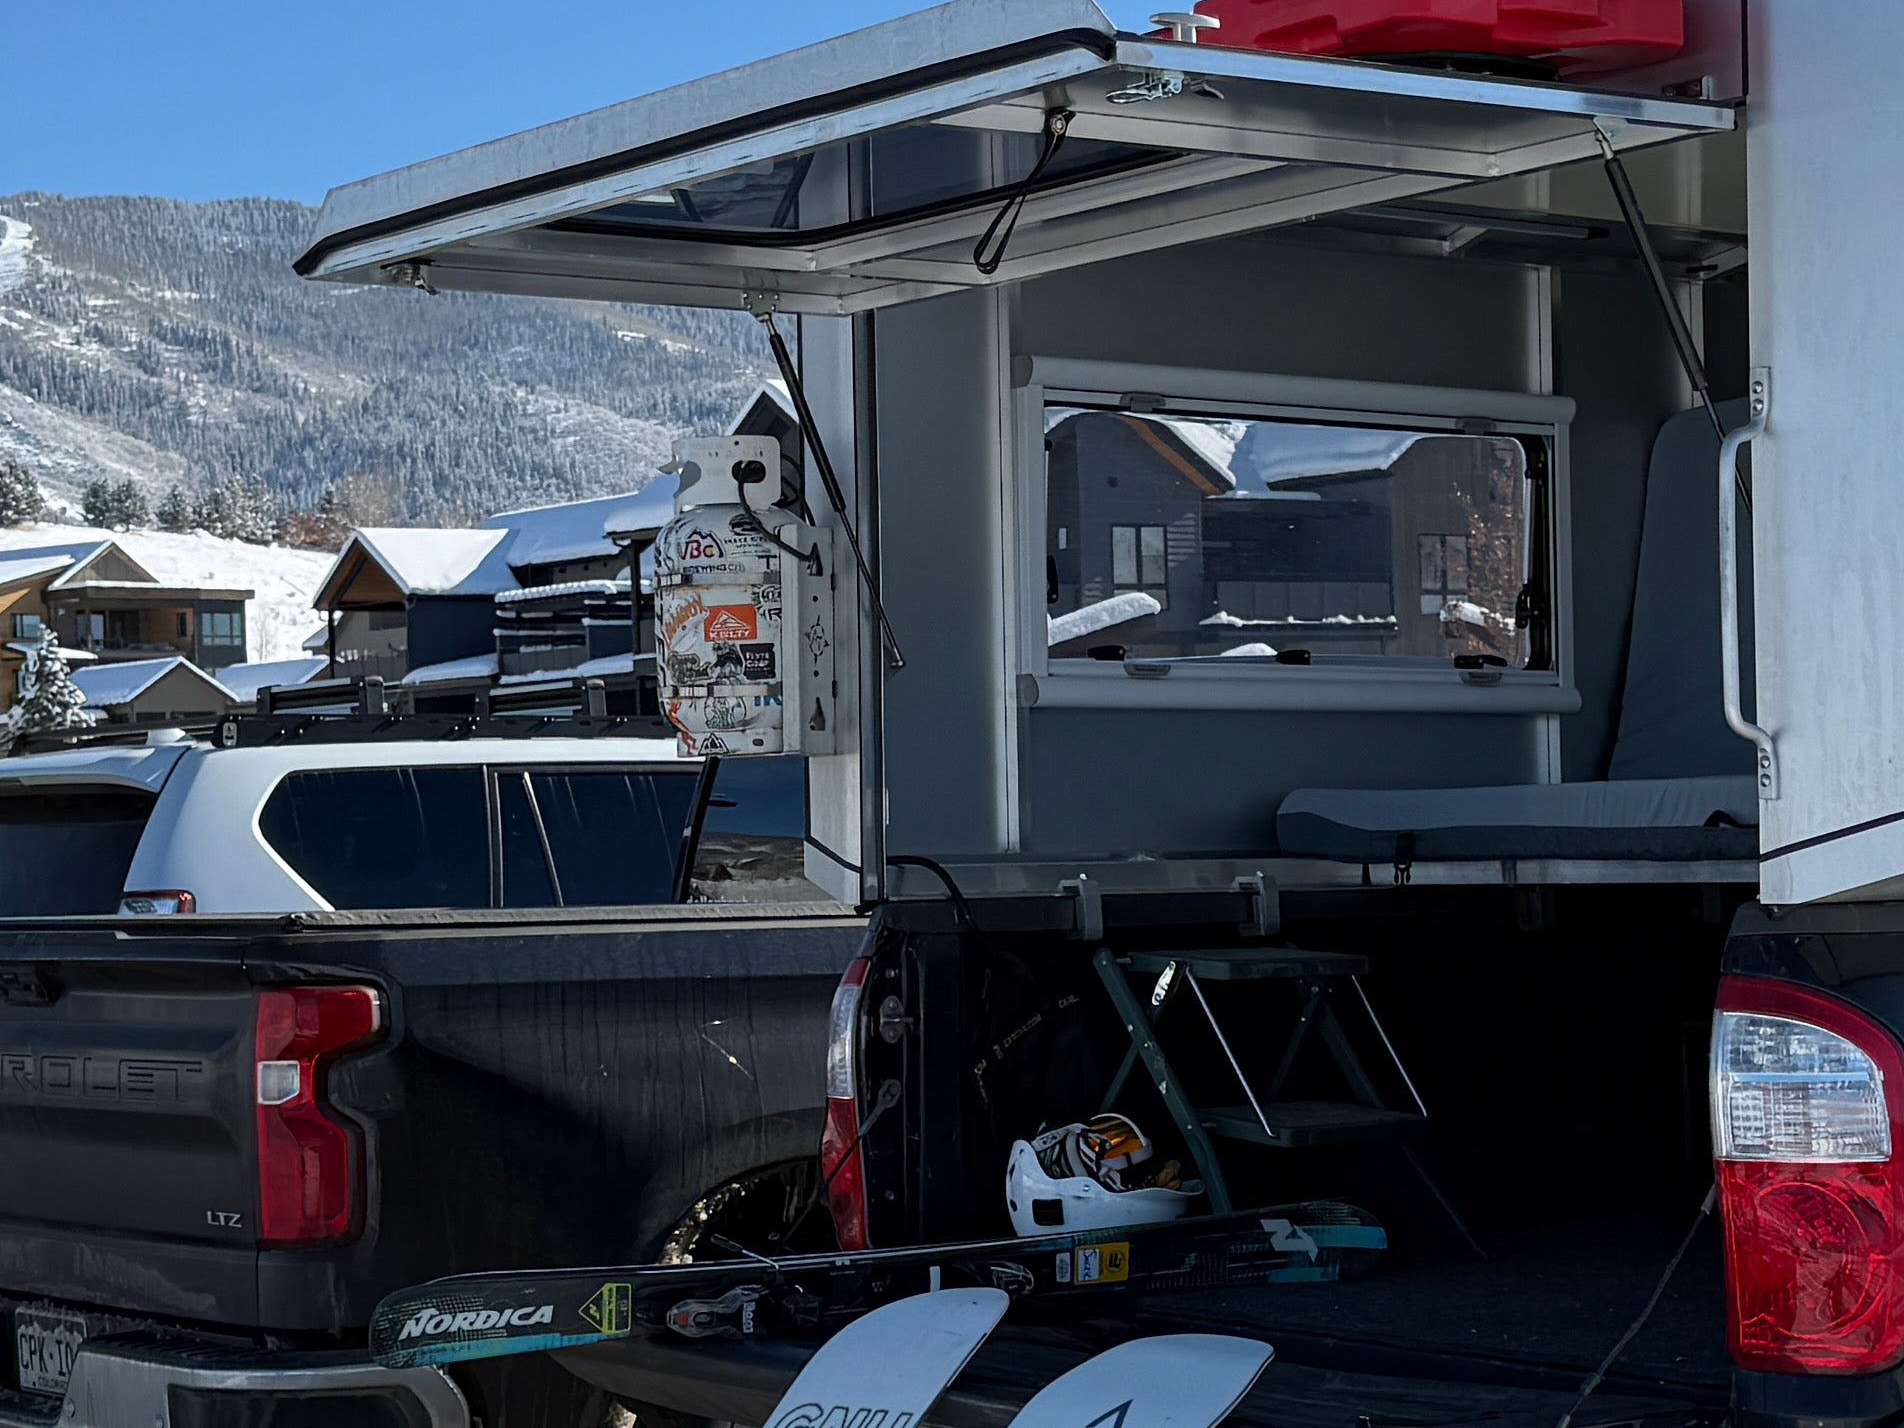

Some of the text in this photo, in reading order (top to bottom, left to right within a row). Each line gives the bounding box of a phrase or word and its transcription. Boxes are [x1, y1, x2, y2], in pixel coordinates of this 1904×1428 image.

[709, 629, 750, 640] KELTY
[206, 1209, 242, 1228] LTZ
[397, 1304, 555, 1342] NORDICA
